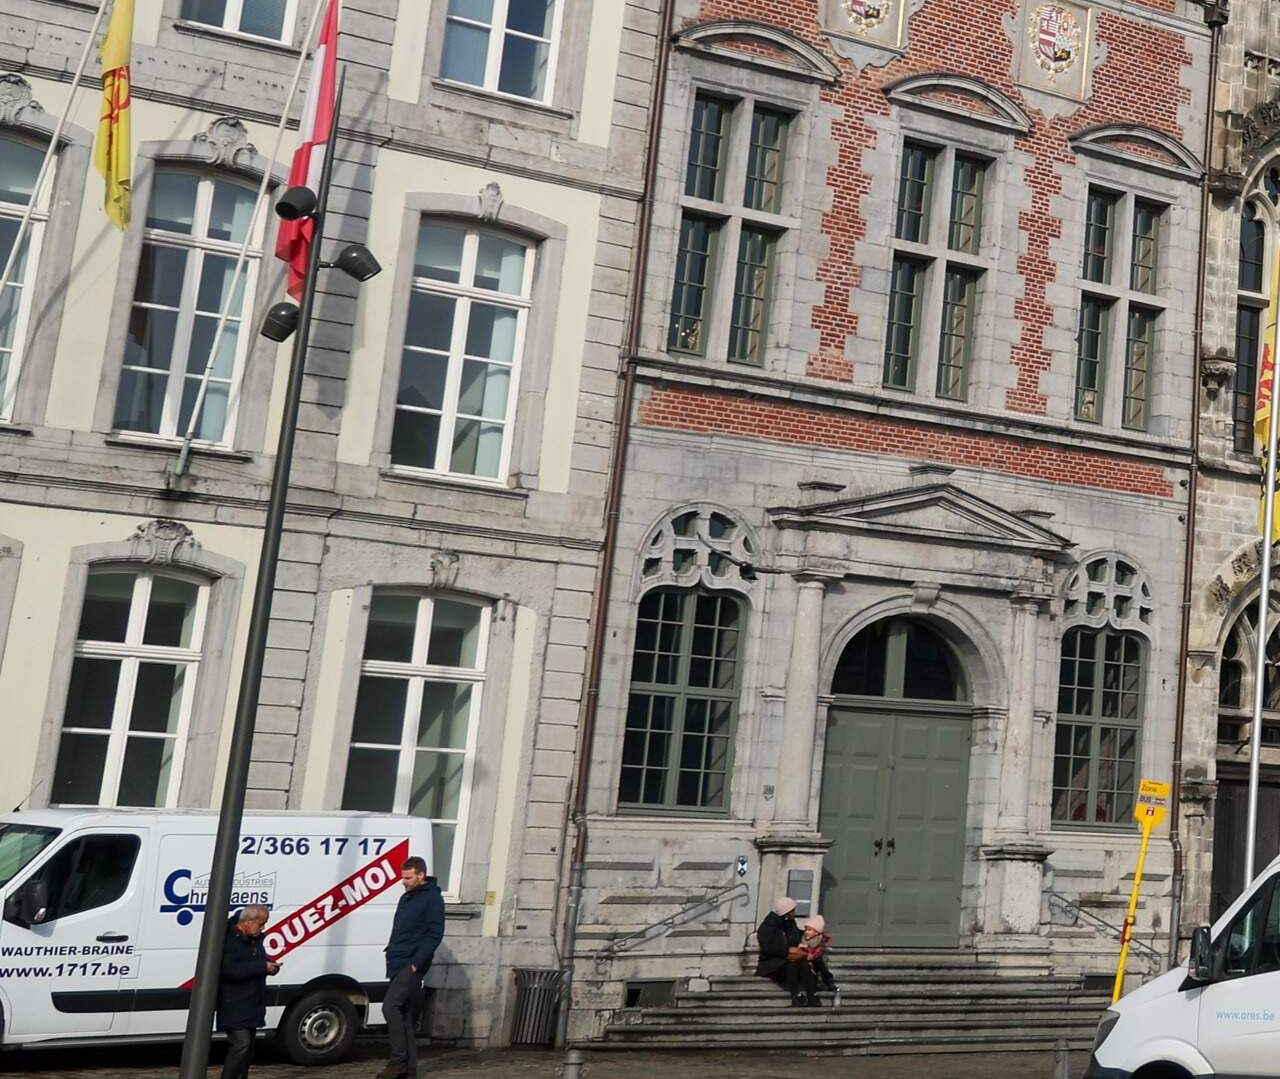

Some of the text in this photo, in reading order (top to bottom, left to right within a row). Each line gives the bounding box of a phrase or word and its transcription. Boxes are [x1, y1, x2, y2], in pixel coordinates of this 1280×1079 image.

[239, 836, 387, 855] 2/366 17 17
[164, 869, 268, 904] Chraens
[262, 859, 397, 957] OUEZ-MOI
[1, 945, 135, 957] WAUTHIER-BRAINE
[0, 962, 131, 978] www.1717.be
